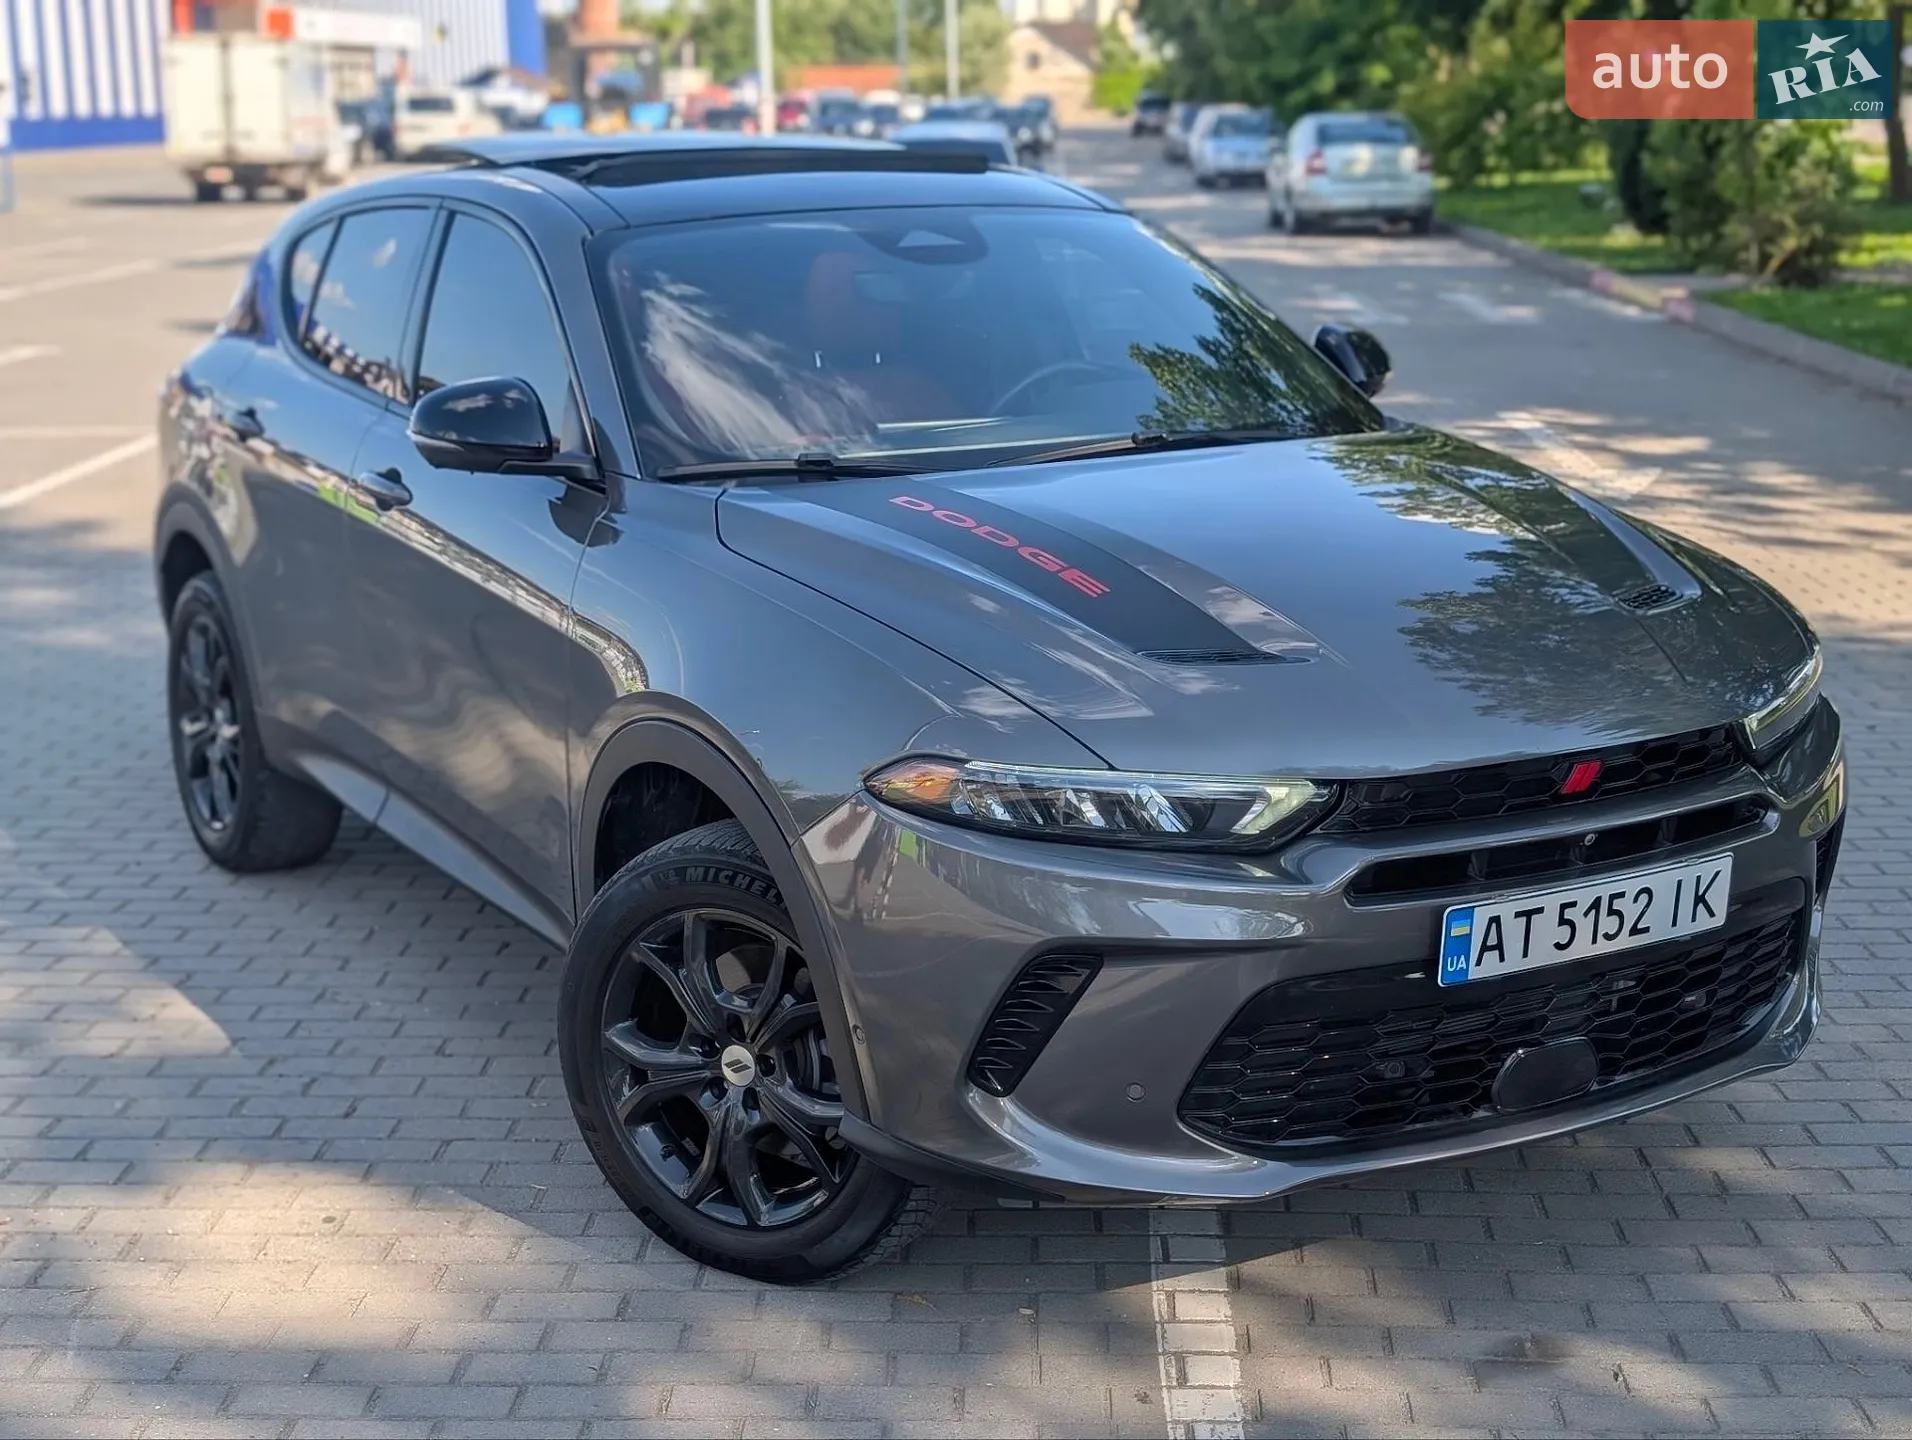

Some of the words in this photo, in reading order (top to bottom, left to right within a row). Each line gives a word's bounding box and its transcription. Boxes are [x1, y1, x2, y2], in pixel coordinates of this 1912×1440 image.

[888, 496, 1111, 598] DODGE
[685, 866, 787, 908] MICHEL
[1475, 906, 1545, 968] AT
[1552, 887, 1655, 952] 5152
[1670, 869, 1723, 929] IK
[1447, 954, 1467, 971] UA
